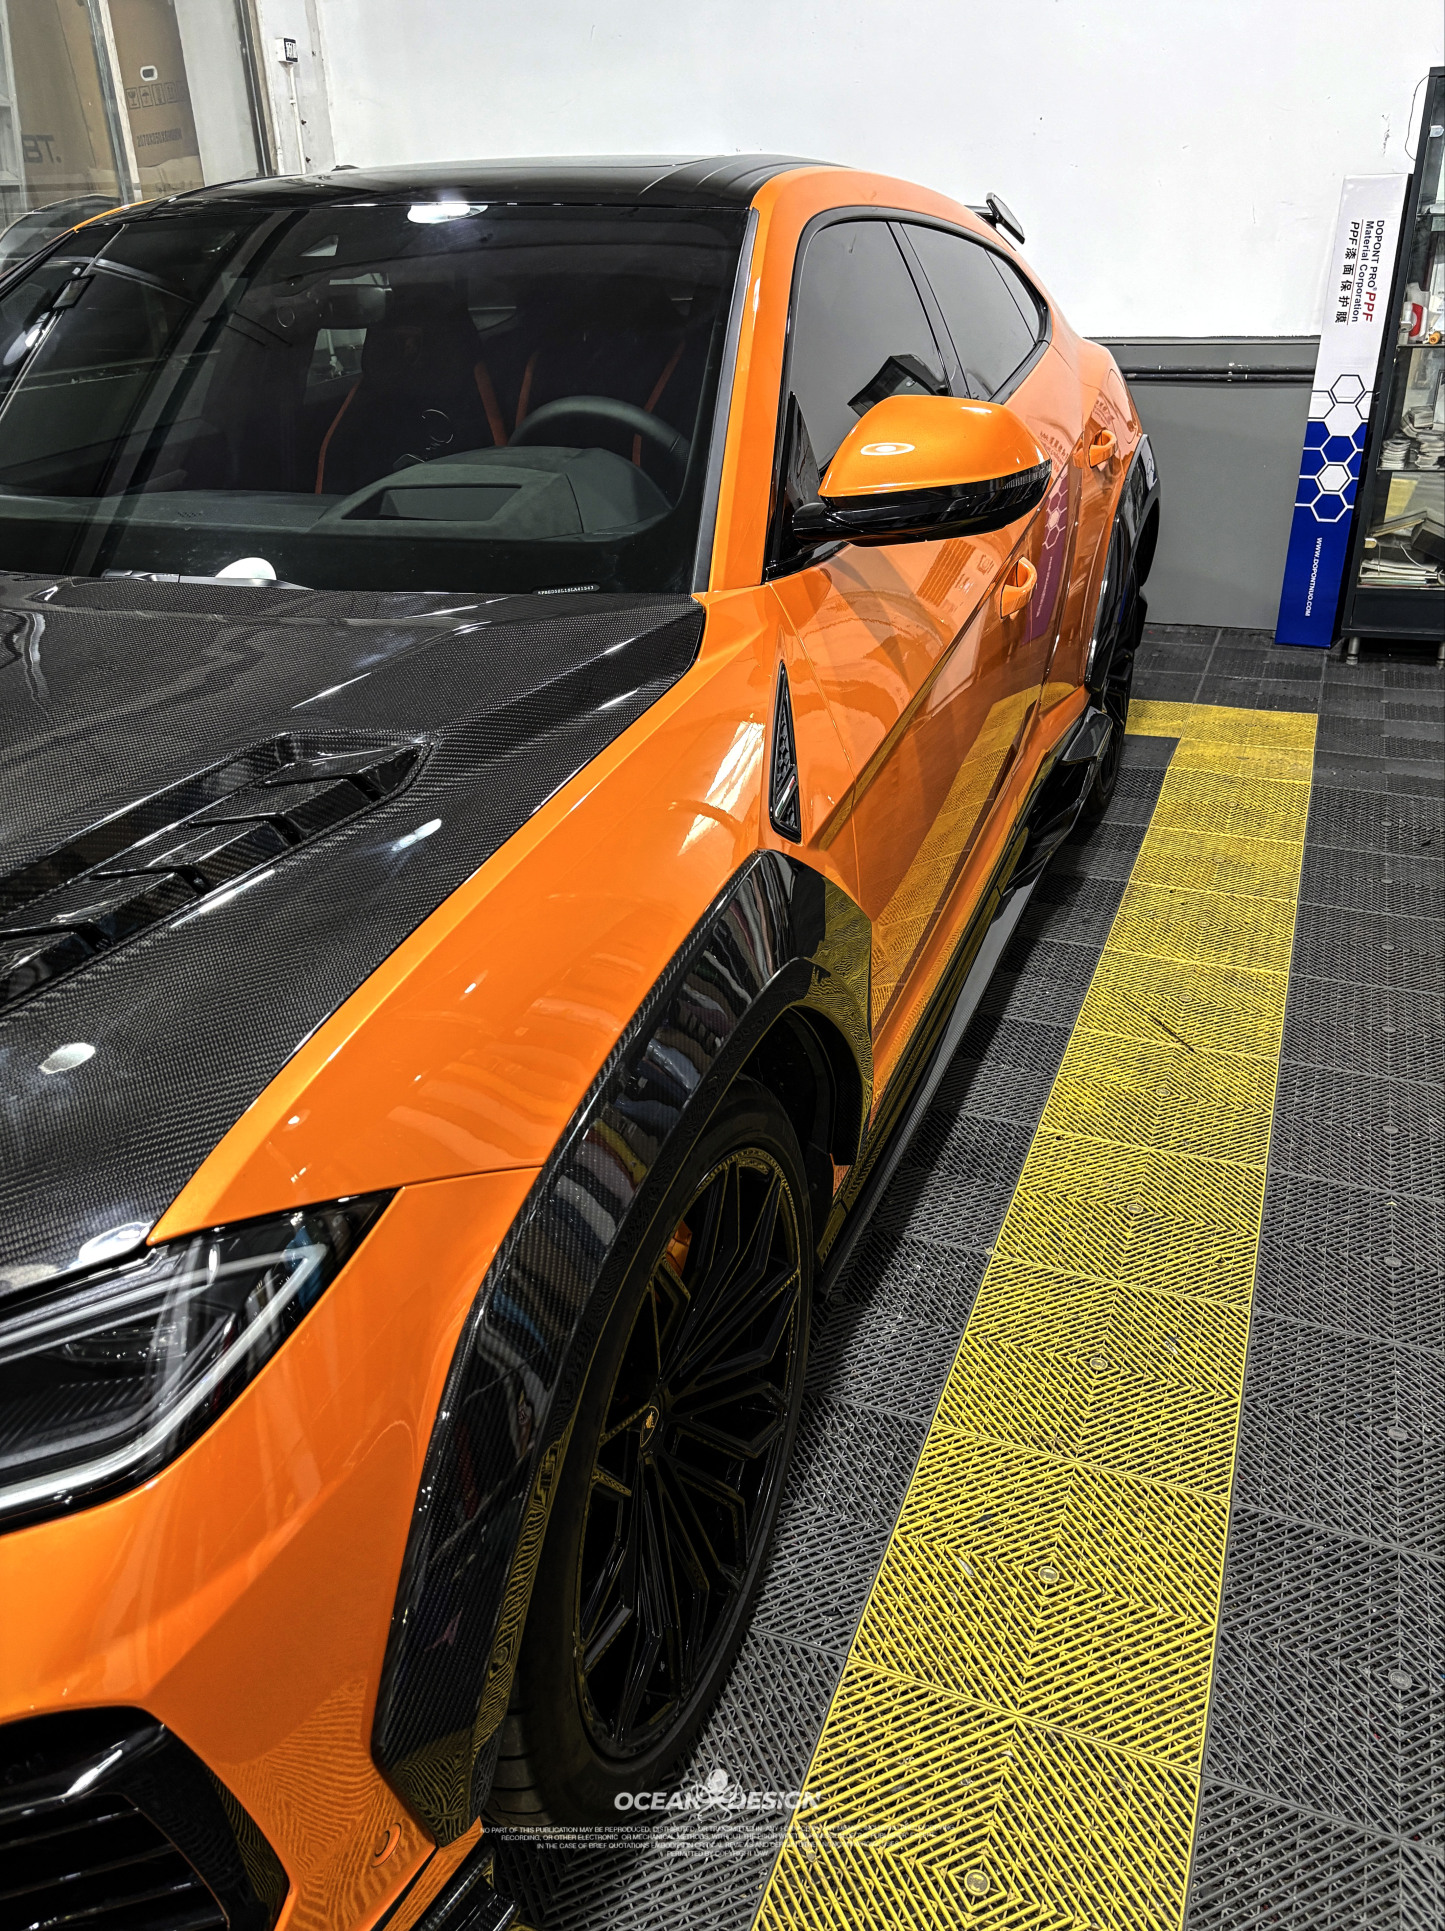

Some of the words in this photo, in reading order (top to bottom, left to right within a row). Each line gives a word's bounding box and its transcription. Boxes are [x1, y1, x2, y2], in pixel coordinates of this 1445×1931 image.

[1361, 220, 1375, 261] Material
[1370, 220, 1385, 264] DOPONT
[1351, 264, 1368, 323] Corporation
[1362, 291, 1376, 323] PPF
